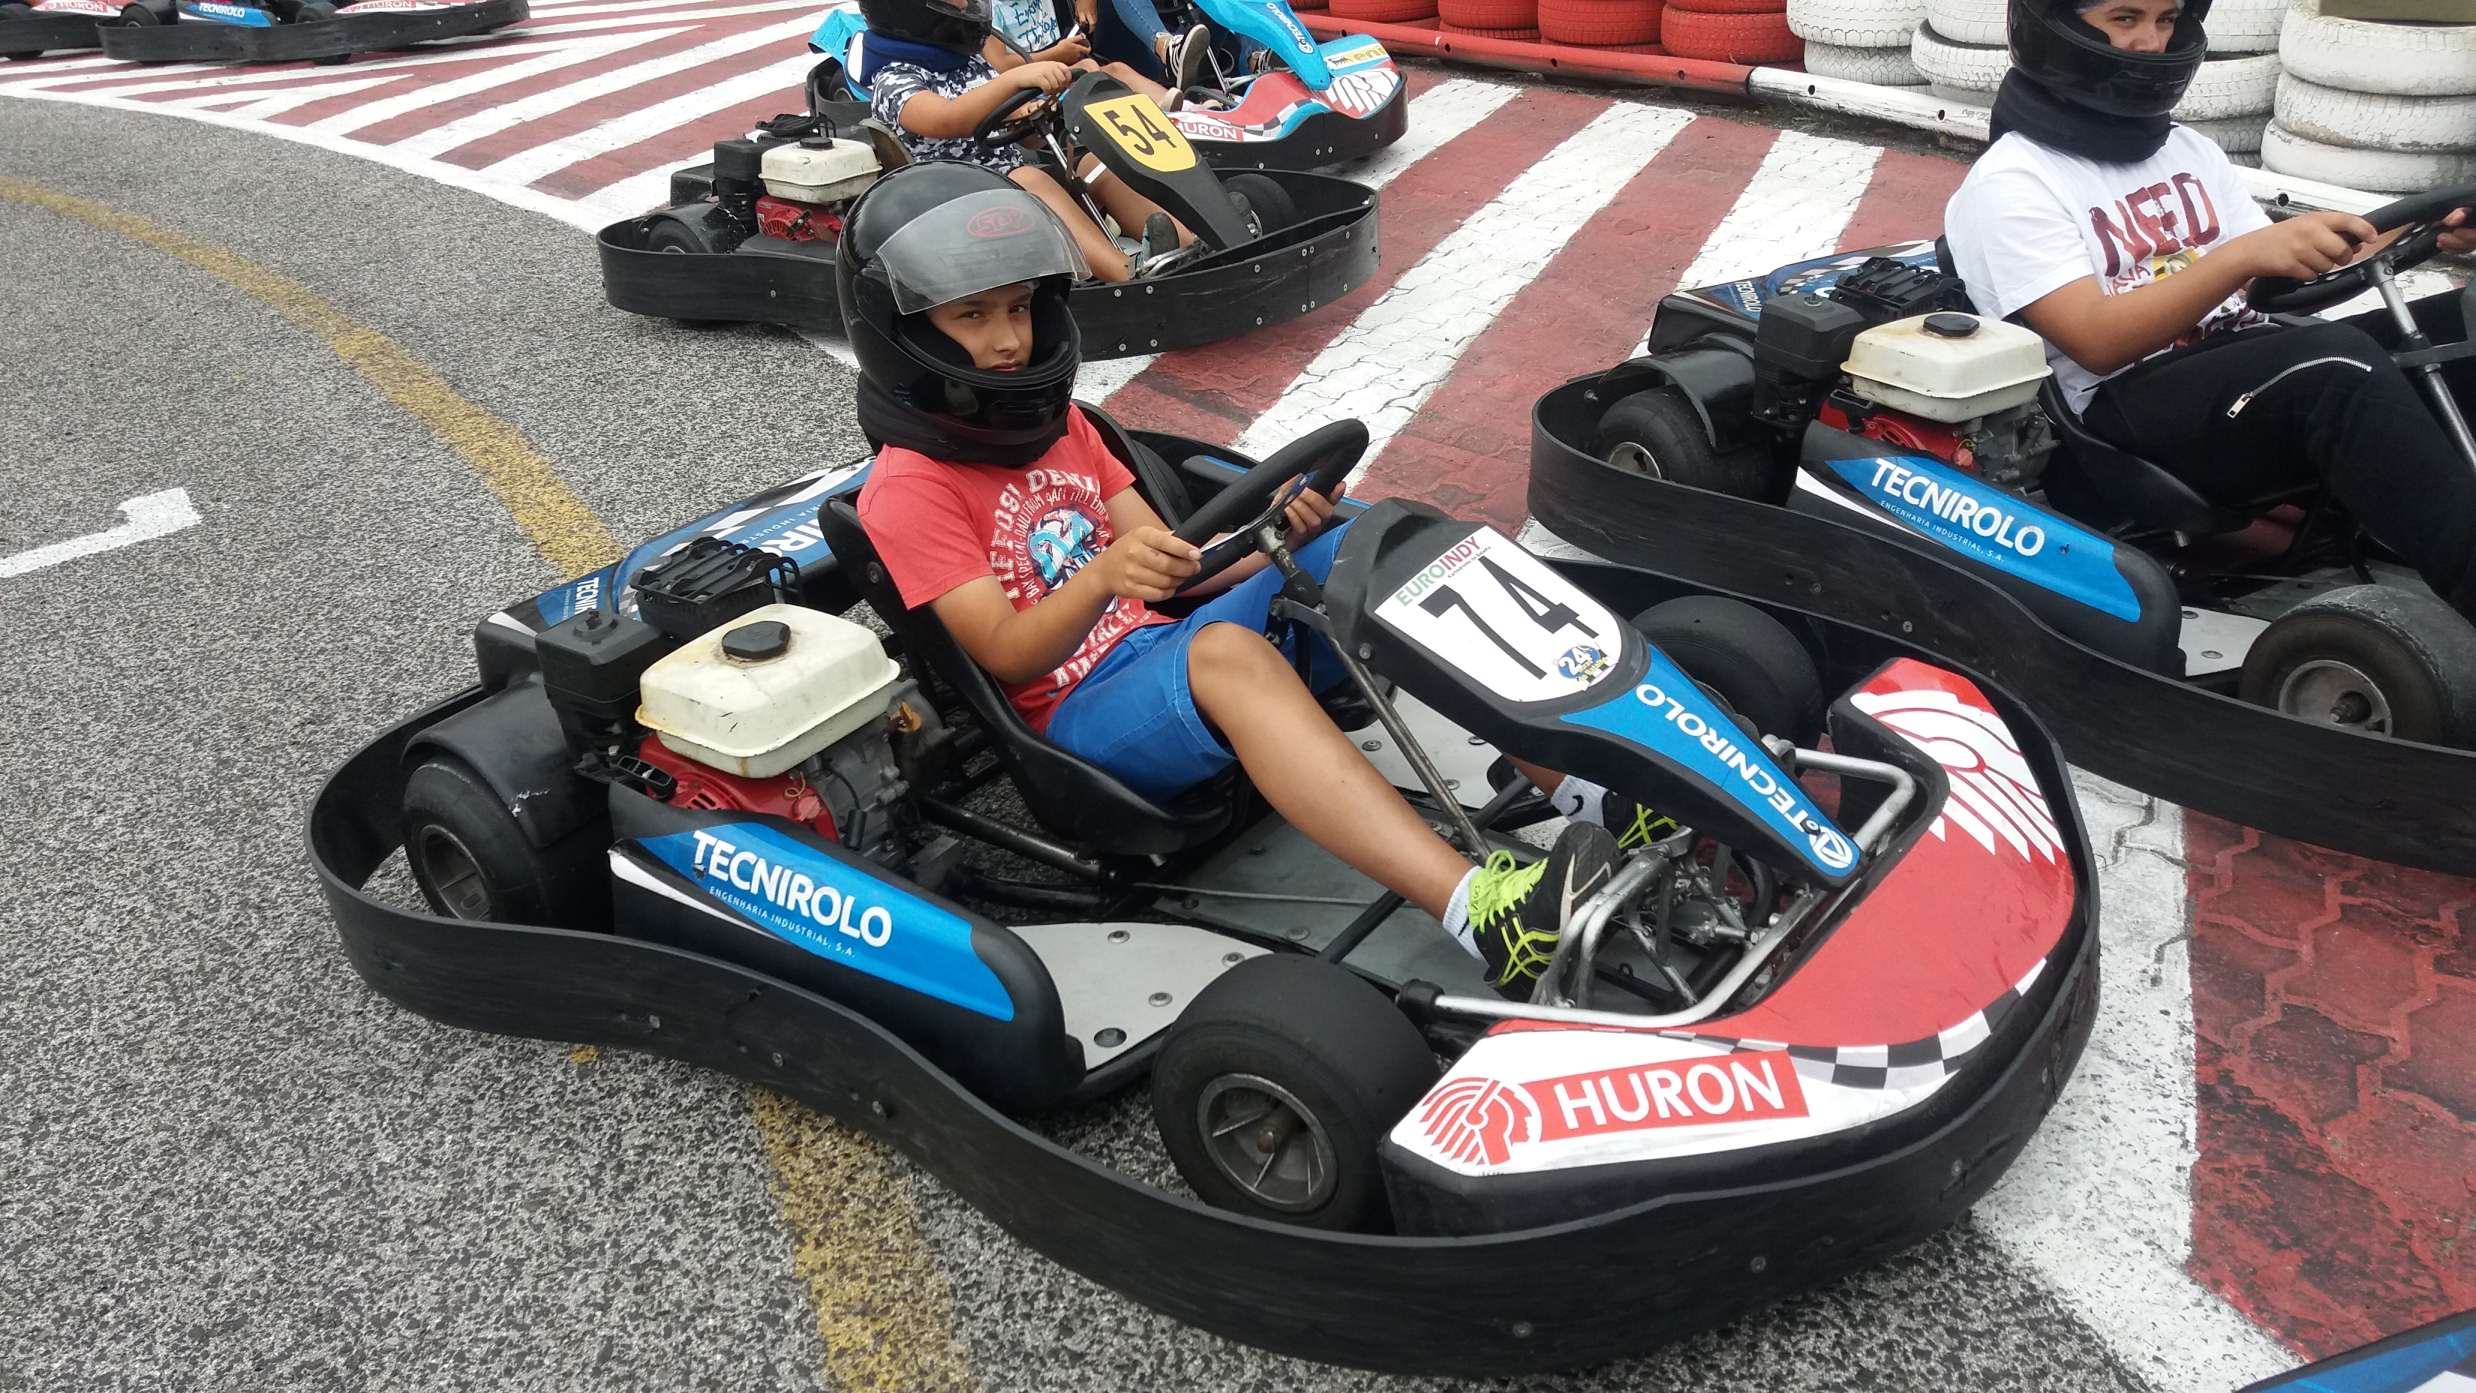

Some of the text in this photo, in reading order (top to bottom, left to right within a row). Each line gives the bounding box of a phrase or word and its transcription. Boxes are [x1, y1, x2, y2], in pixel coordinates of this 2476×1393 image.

[199, 2, 246, 18] TECNIROLO
[1102, 103, 1176, 157] 54
[2088, 172, 2221, 278] NEED
[1869, 458, 2046, 557] TECNIROLO
[1880, 499, 1931, 529] ENGENHARIA
[1395, 536, 1480, 607] EUROINDY
[1418, 555, 1599, 680] 74
[1558, 646, 1591, 676] 24
[1635, 683, 1809, 833] TECNIROLO
[692, 829, 893, 948] TECNIROLO
[709, 885, 768, 920] ENGENHARIA
[835, 940, 856, 957] S.A.
[1553, 1058, 1785, 1130] HURON
